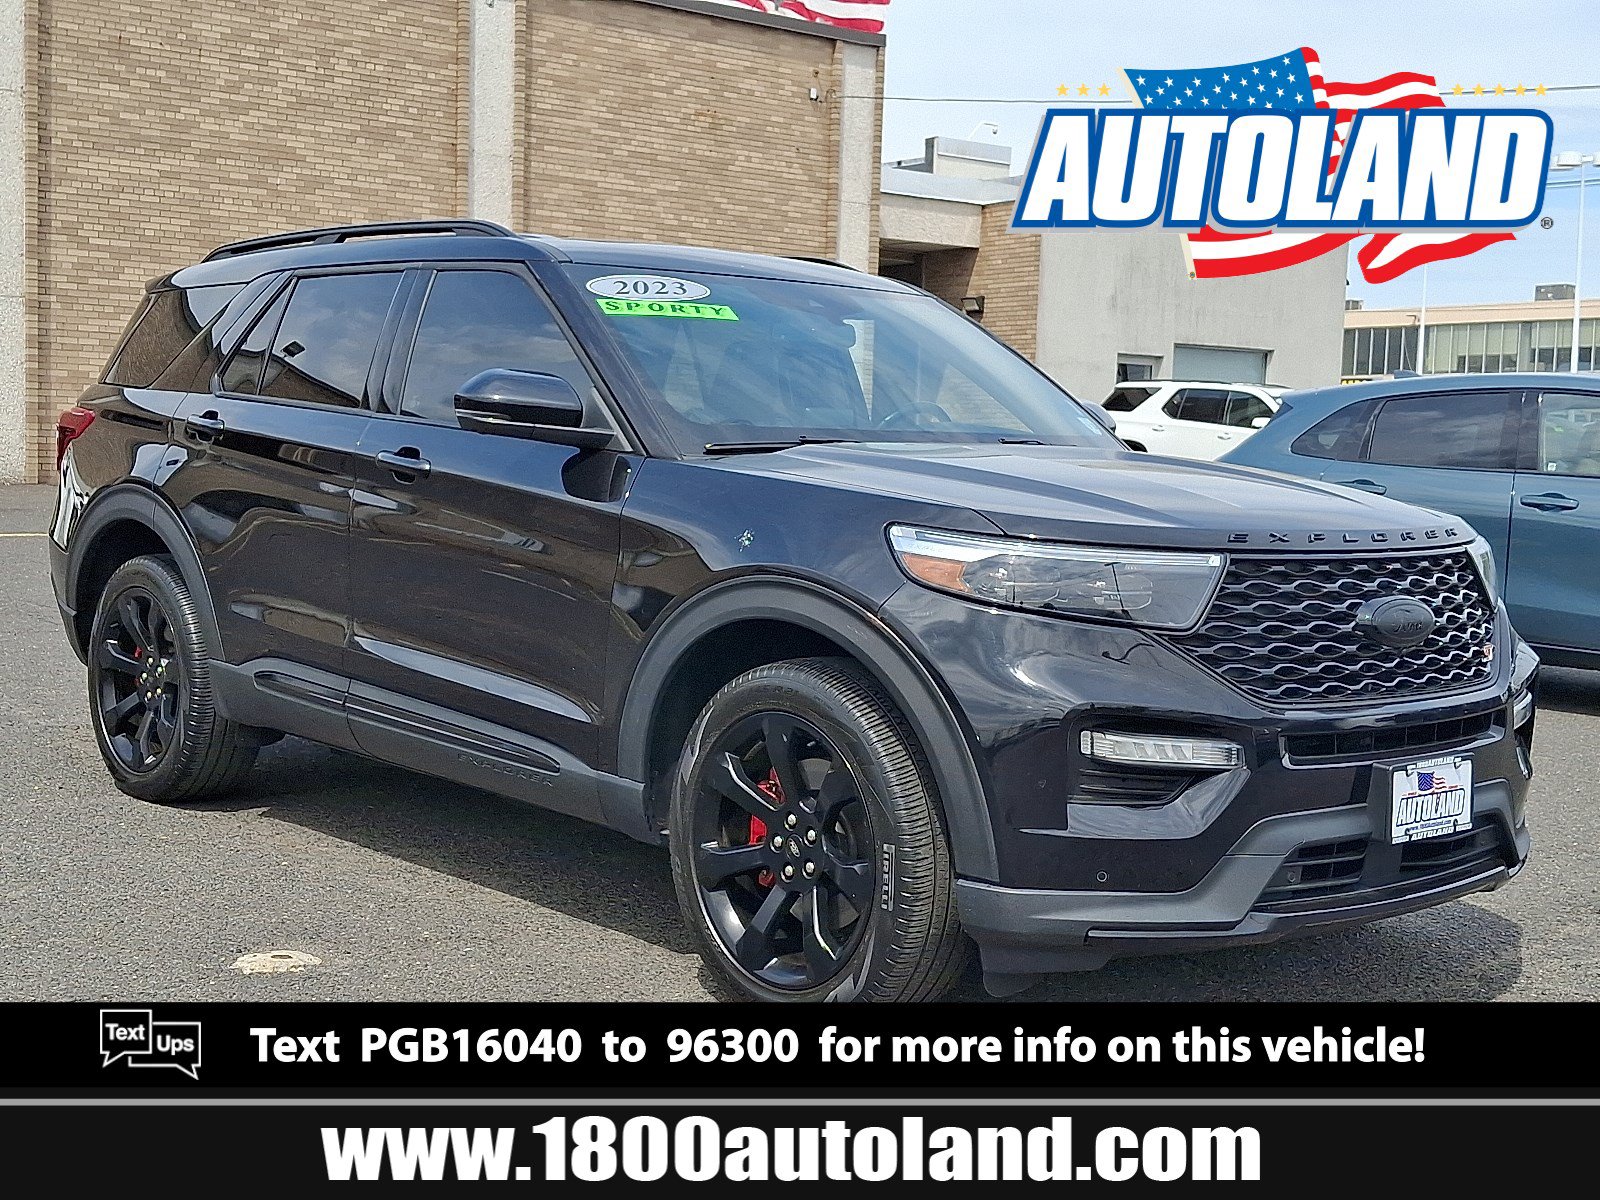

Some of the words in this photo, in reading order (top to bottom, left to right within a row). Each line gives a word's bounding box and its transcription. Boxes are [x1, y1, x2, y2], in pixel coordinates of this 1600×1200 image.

[613, 280, 688, 296] 2023
[605, 301, 728, 316] SPORTY
[1227, 527, 1458, 544] EXPLORER
[1396, 788, 1464, 827] AUTOLAND
[881, 843, 896, 912] PIRELLI
